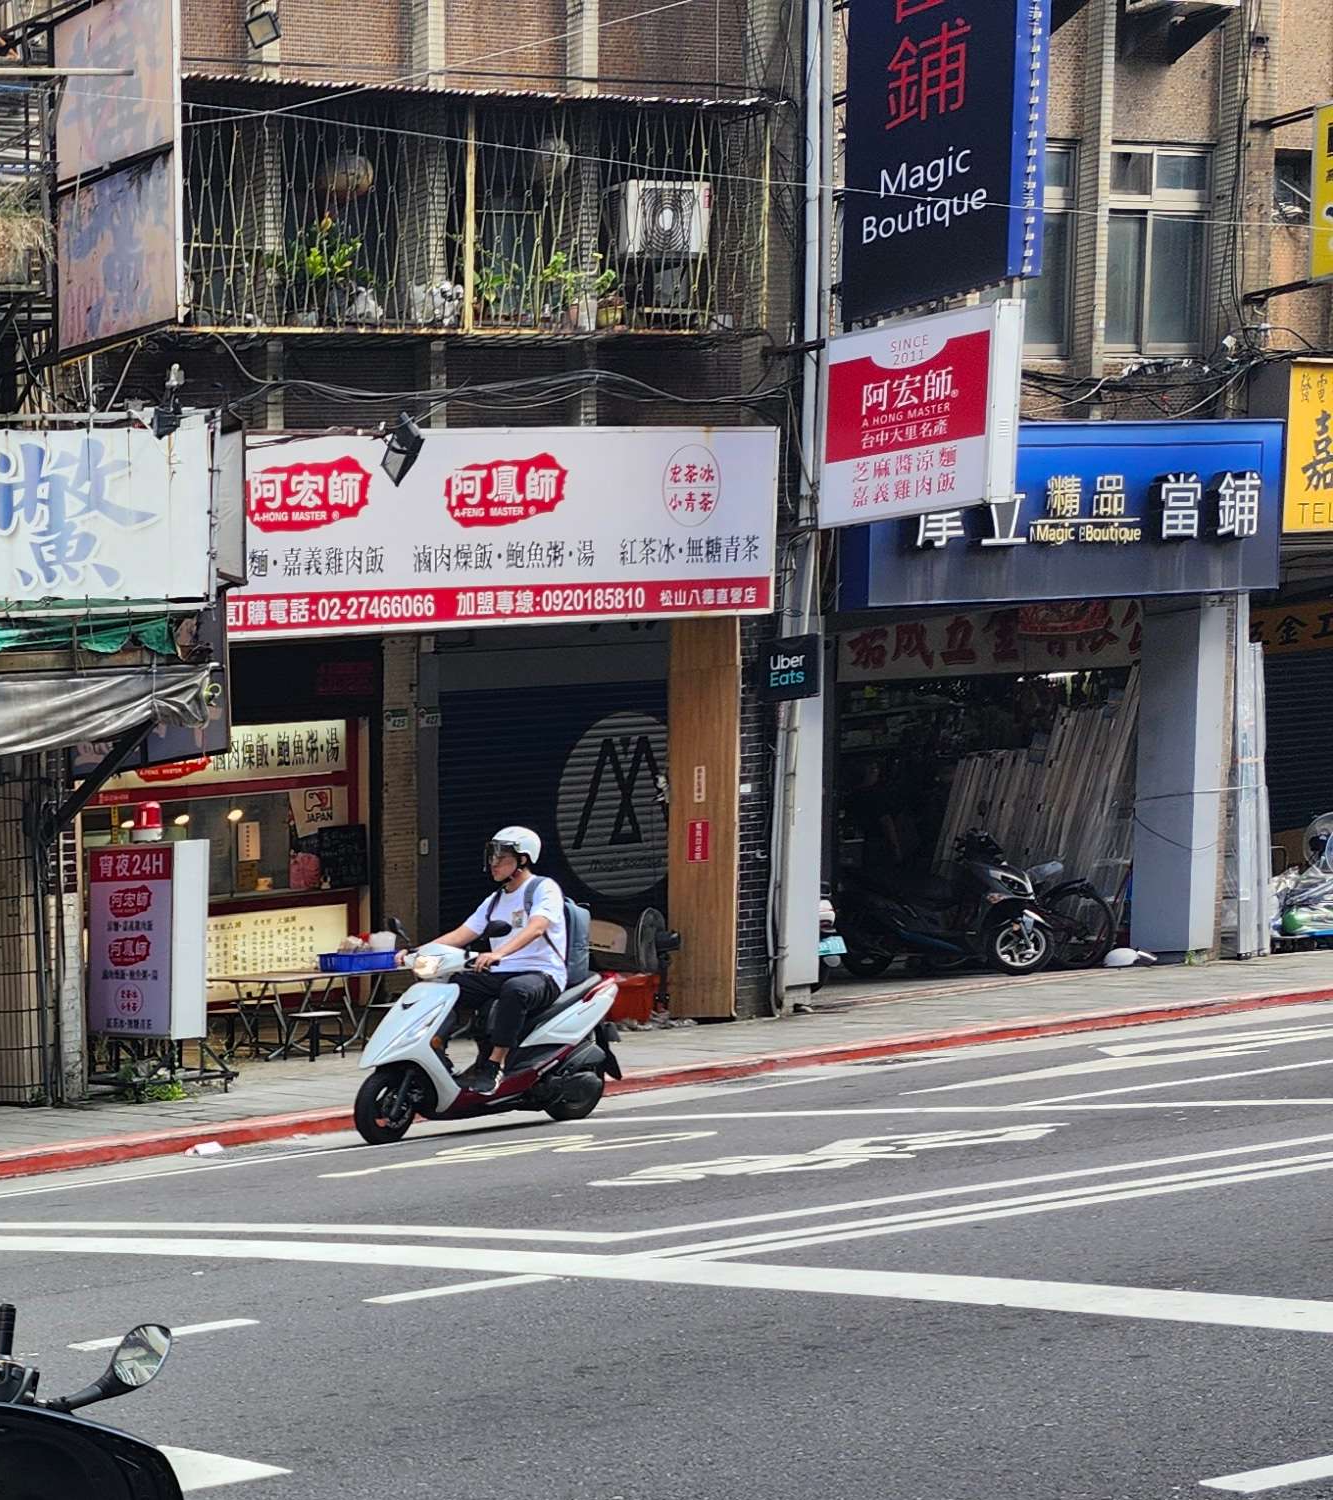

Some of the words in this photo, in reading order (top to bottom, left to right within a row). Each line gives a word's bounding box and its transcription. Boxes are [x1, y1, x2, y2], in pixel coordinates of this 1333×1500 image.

[885, 0, 971, 130] 鋪
[880, 146, 971, 199] Magic
[862, 187, 987, 245] Boutique
[890, 335, 930, 353] SINCE
[893, 351, 924, 366] 2011
[861, 366, 954, 416] 阿宏師
[862, 418, 869, 428] A
[873, 410, 904, 427] HONG
[907, 402, 951, 420] MASTER
[861, 418, 948, 450] 台中大里名產
[853, 445, 958, 484] 芝麻醬涼麵
[249, 471, 364, 509] 阿宏師
[450, 466, 561, 506] 阿鳳師
[852, 472, 956, 508] 嘉義雞肉飯
[253, 512, 289, 522] A-HONG
[292, 511, 327, 521] MASTER
[453, 507, 485, 518] A-FENG
[489, 505, 524, 516] MASTER
[669, 491, 714, 512] 小青茶
[1047, 475, 1125, 518] 精品
[1161, 472, 1261, 539] 當鋪
[1036, 524, 1076, 543] Magic
[1085, 524, 1142, 545] Boutique
[456, 586, 645, 616] 加盟專線:0920185810
[770, 654, 805, 670] Uber
[770, 670, 805, 687] Eats
[99, 853, 164, 878] 宵夜24H
